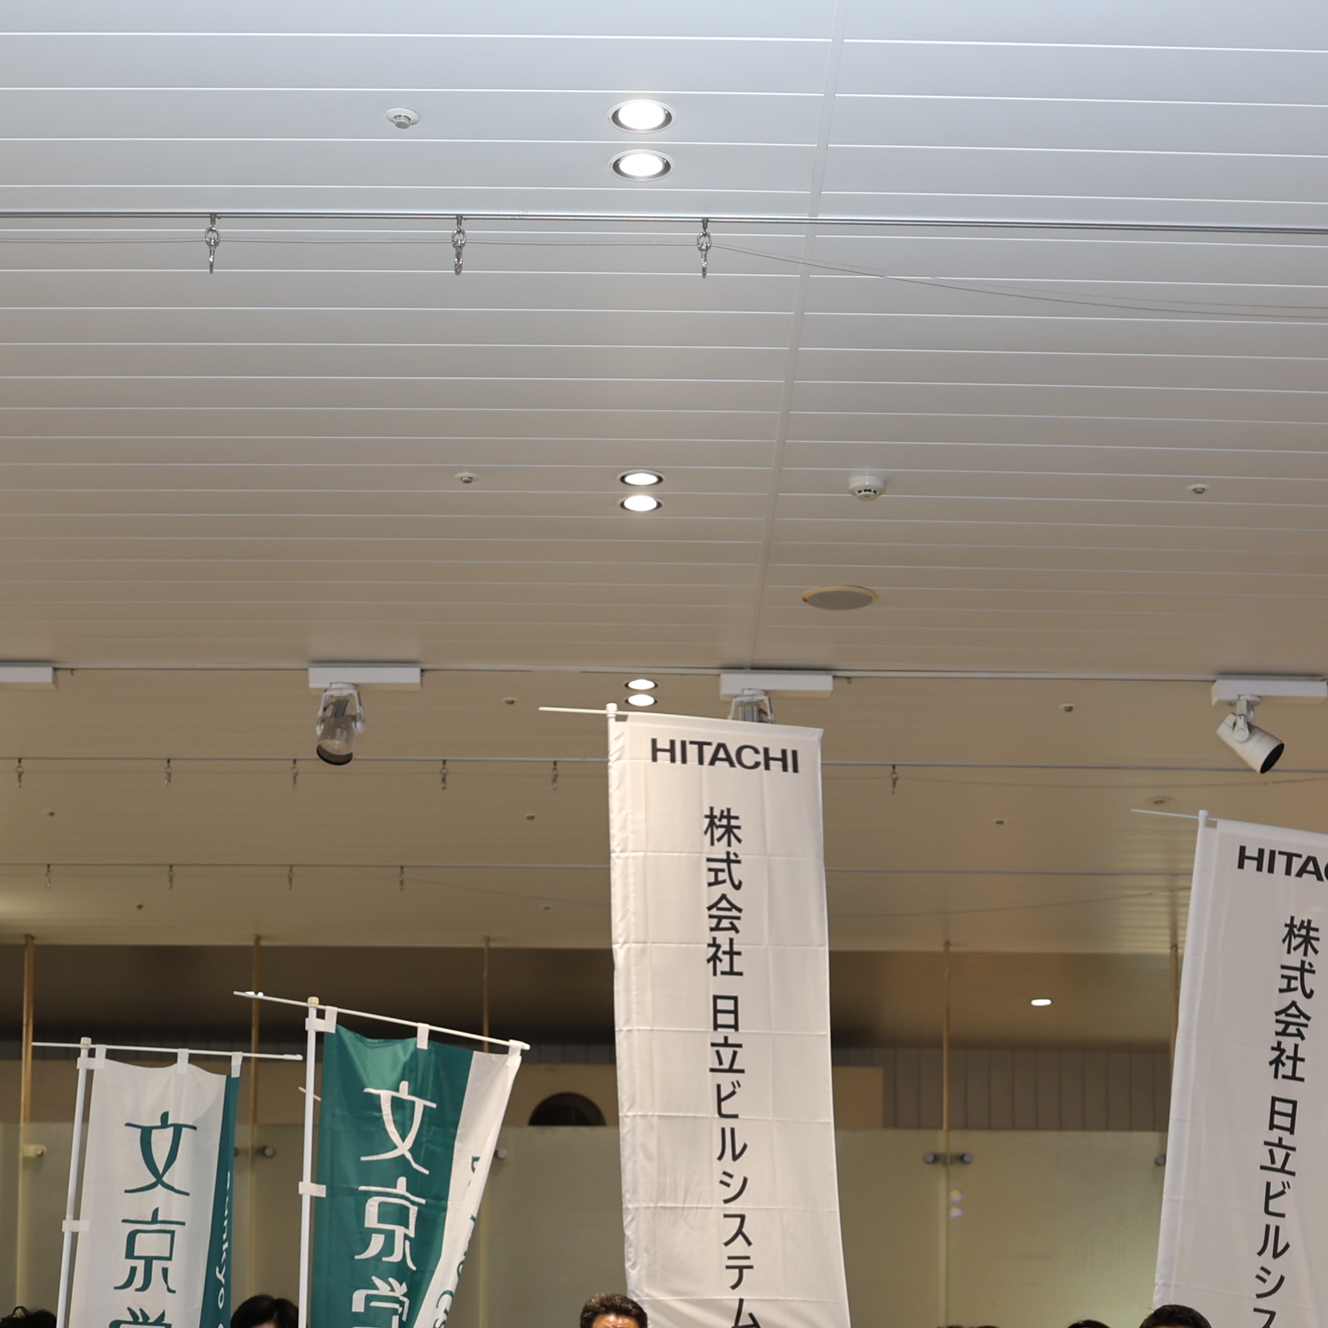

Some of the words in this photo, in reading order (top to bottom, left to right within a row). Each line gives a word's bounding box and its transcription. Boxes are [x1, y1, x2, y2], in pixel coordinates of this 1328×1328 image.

[651, 737, 800, 774] HITACHI
[703, 805, 744, 978] 株式会社
[1268, 915, 1321, 1083] 株式会社
